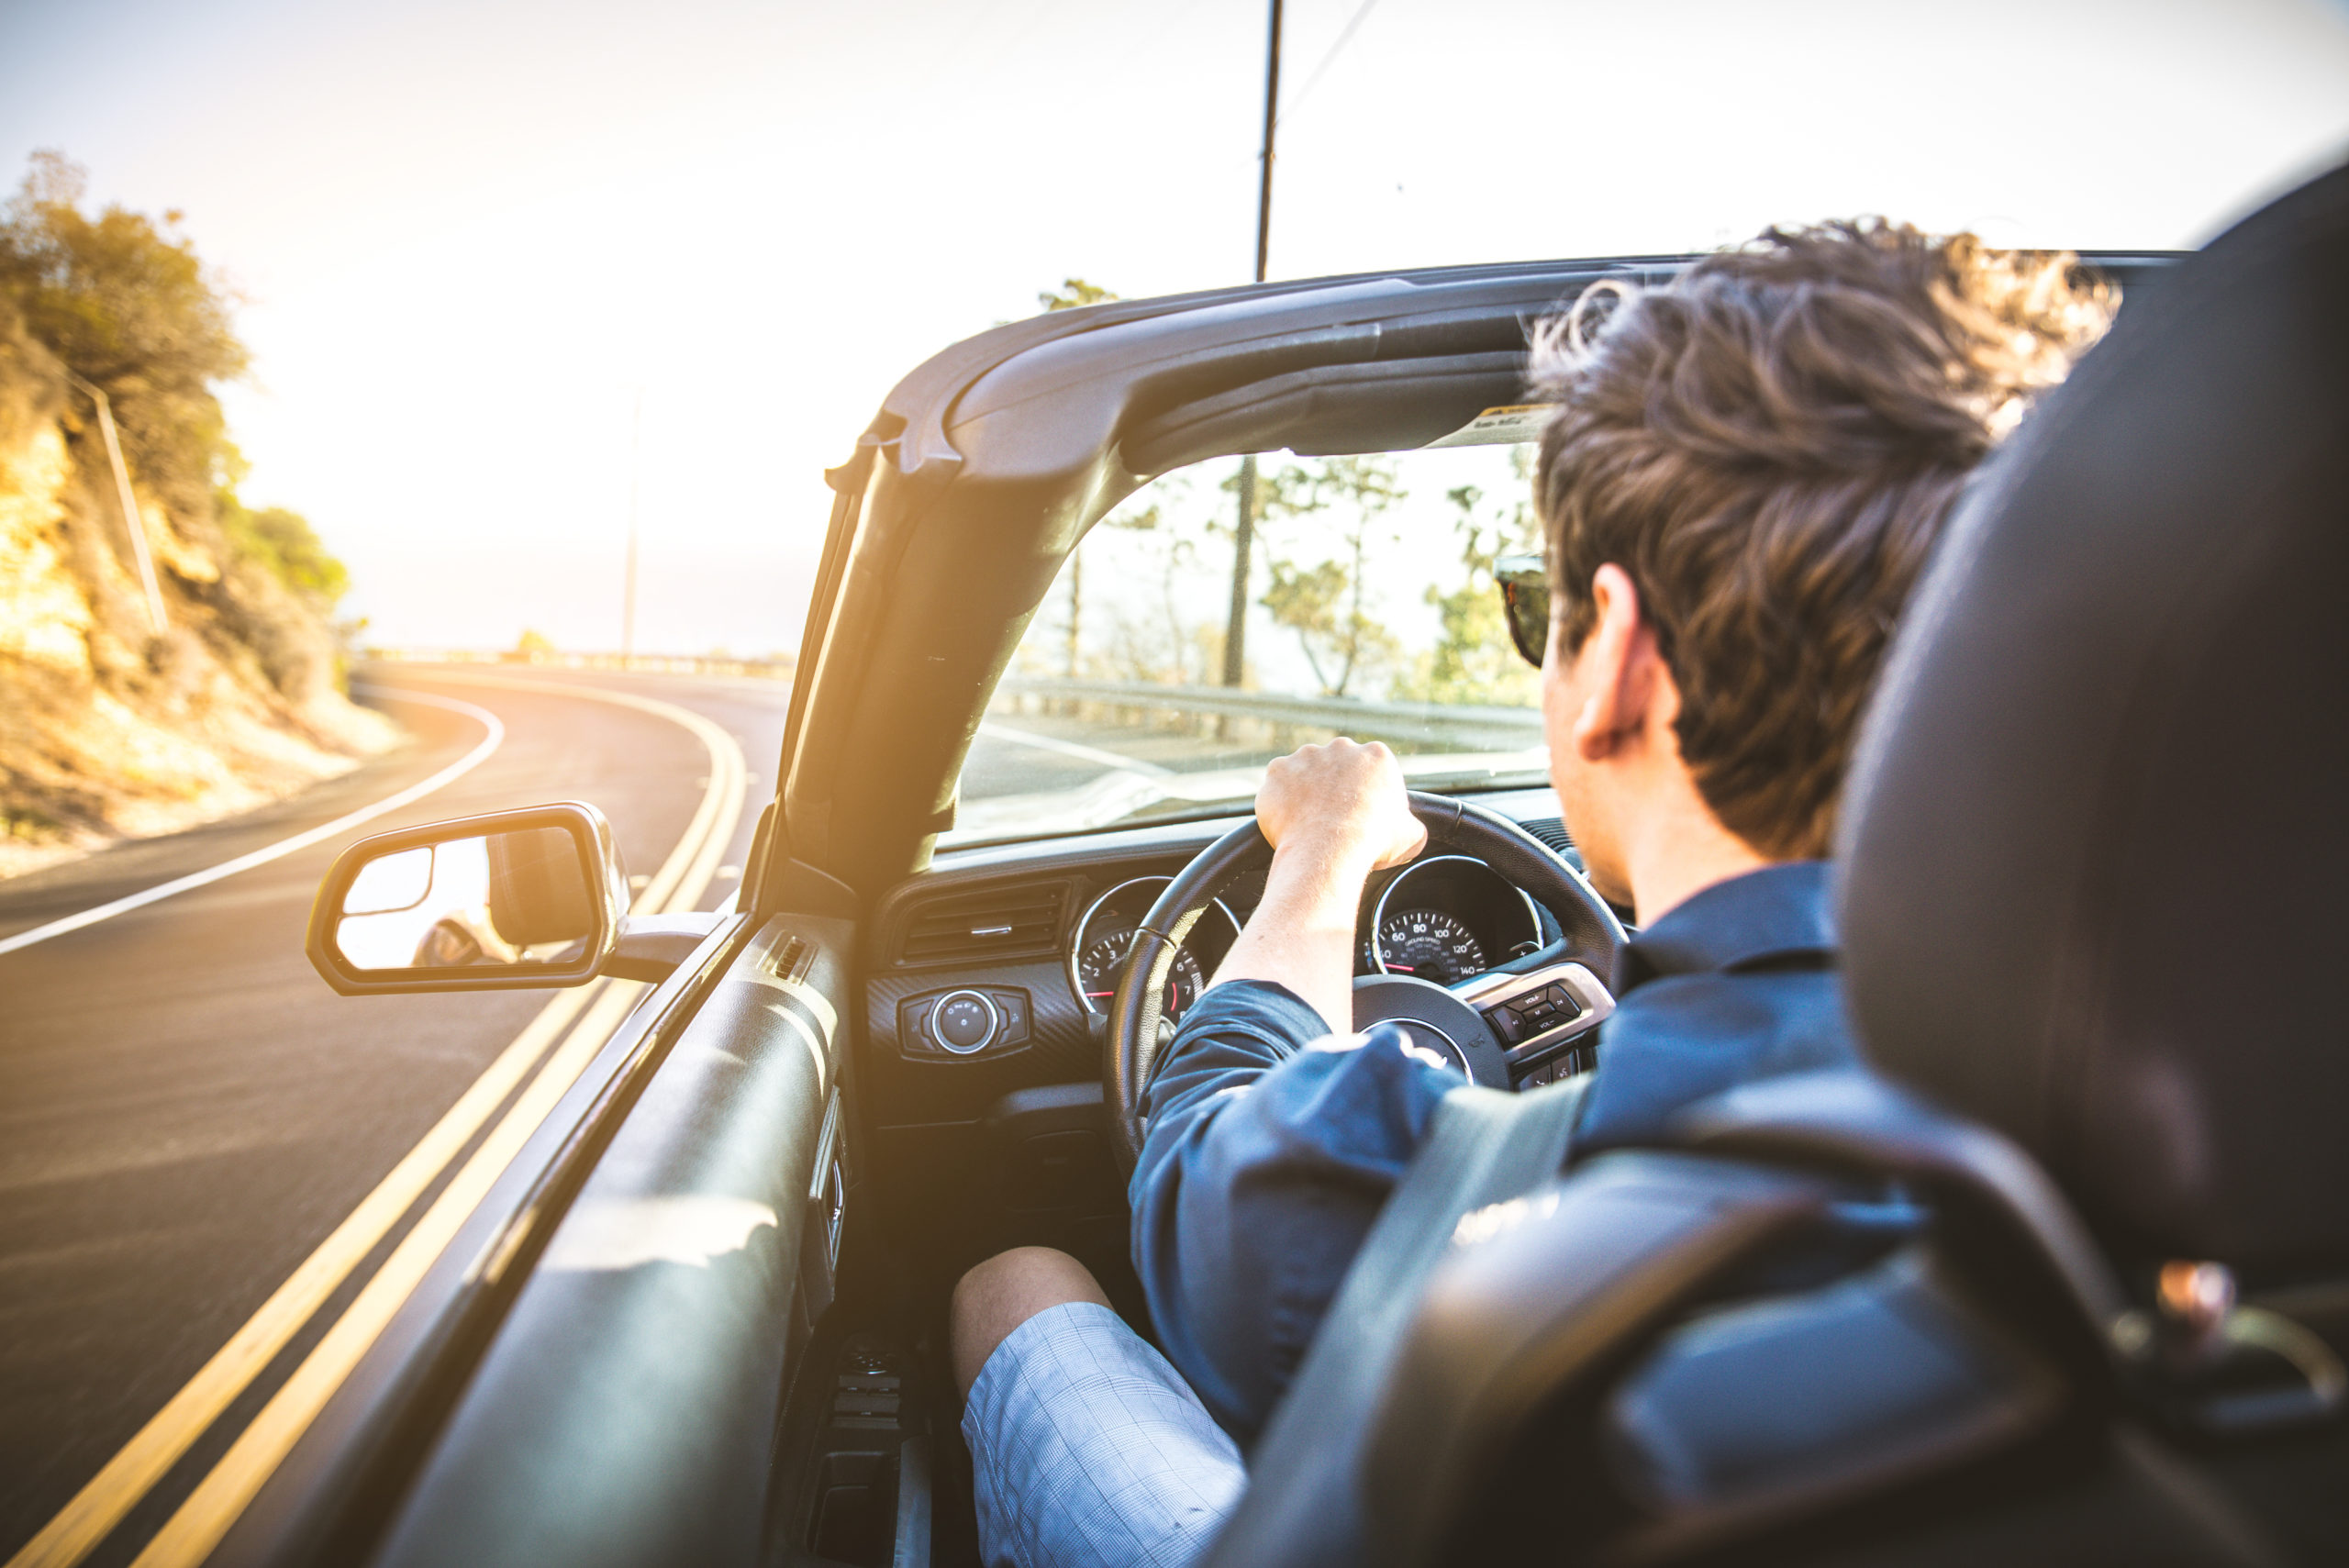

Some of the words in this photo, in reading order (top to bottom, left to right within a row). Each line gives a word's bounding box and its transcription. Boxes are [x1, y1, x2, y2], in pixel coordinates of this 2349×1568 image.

[1413, 924, 1426, 933] 80
[1392, 932, 1405, 941] 60
[1434, 929, 1450, 938] 100
[1453, 945, 1467, 953] 120
[1109, 950, 1116, 960] 3
[1176, 962, 1185, 972] 6
[1460, 966, 1475, 974] 140
[1093, 968, 1100, 976] 2
[1185, 985, 1191, 995] 7
